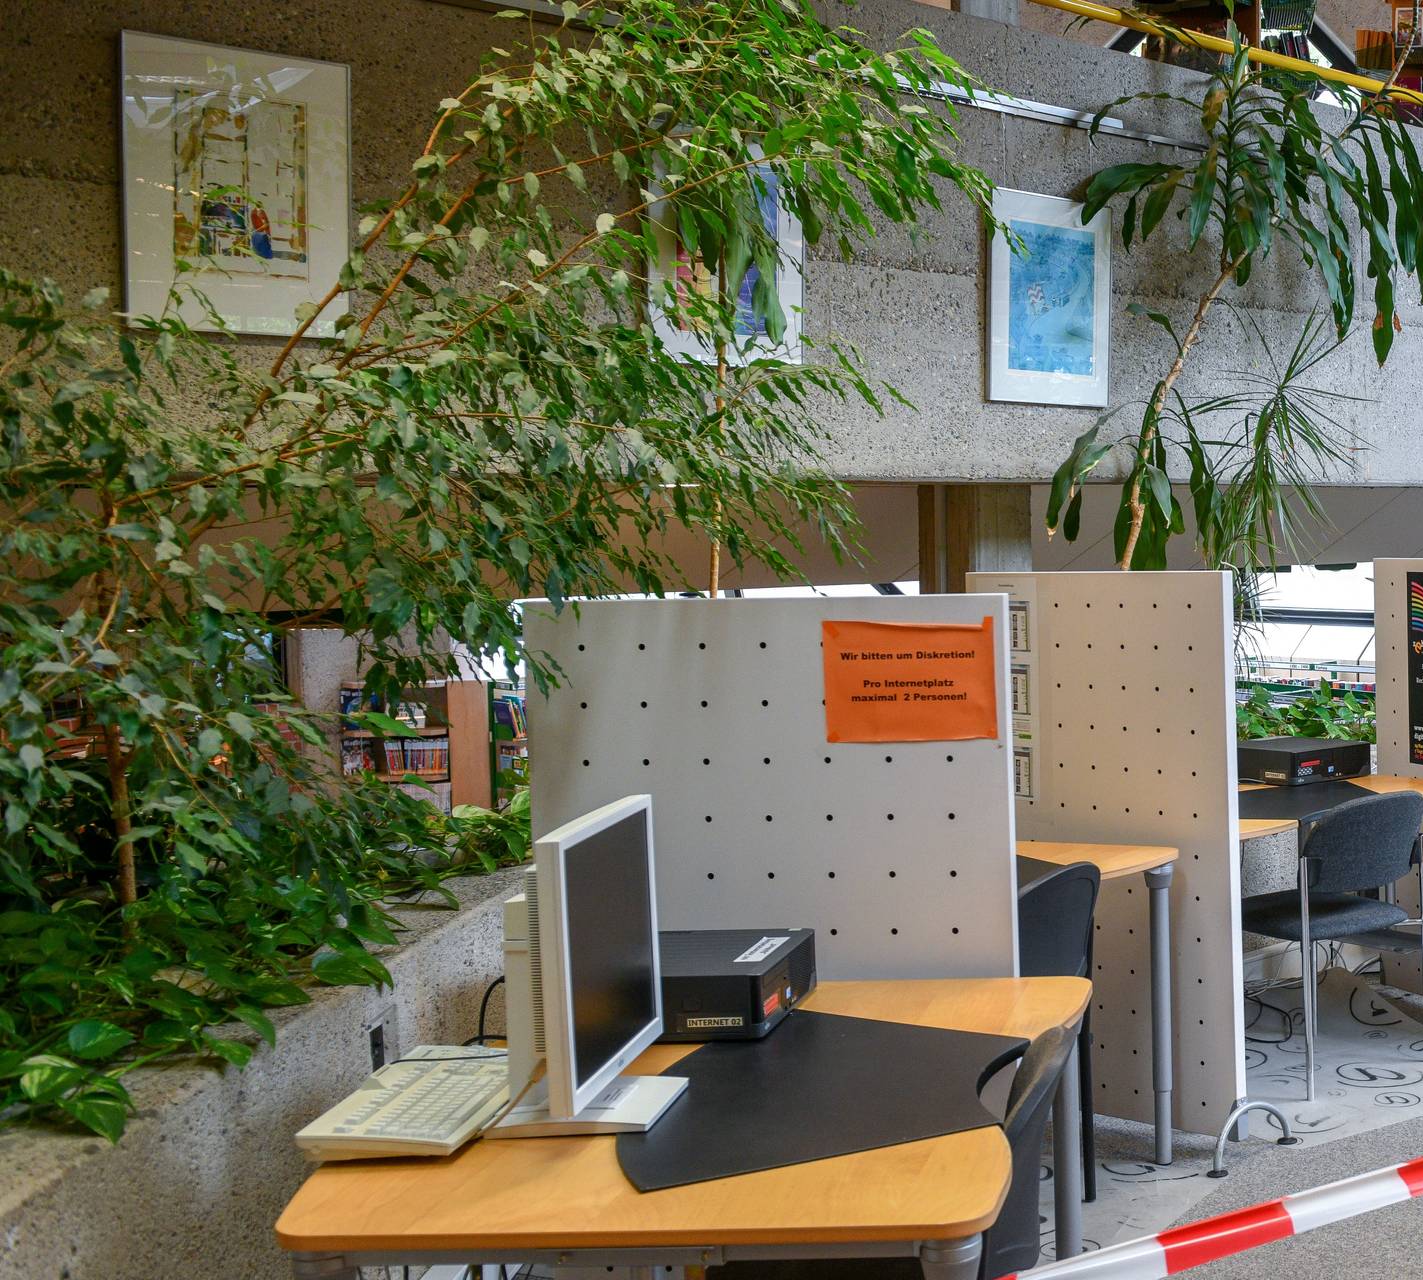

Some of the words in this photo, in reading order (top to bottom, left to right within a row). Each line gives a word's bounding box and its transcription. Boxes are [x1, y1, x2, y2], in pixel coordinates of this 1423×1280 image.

[840, 652, 858, 660] Wir
[861, 651, 893, 660] bitten
[896, 652, 913, 660] um
[916, 650, 975, 659] Diskretion!
[863, 680, 881, 688] Pro
[884, 679, 954, 689] Internetplatz
[851, 694, 897, 702] maximal
[914, 693, 967, 701] Personen!
[688, 1019, 729, 1027] INTERNET
[731, 1018, 741, 1026] 02
